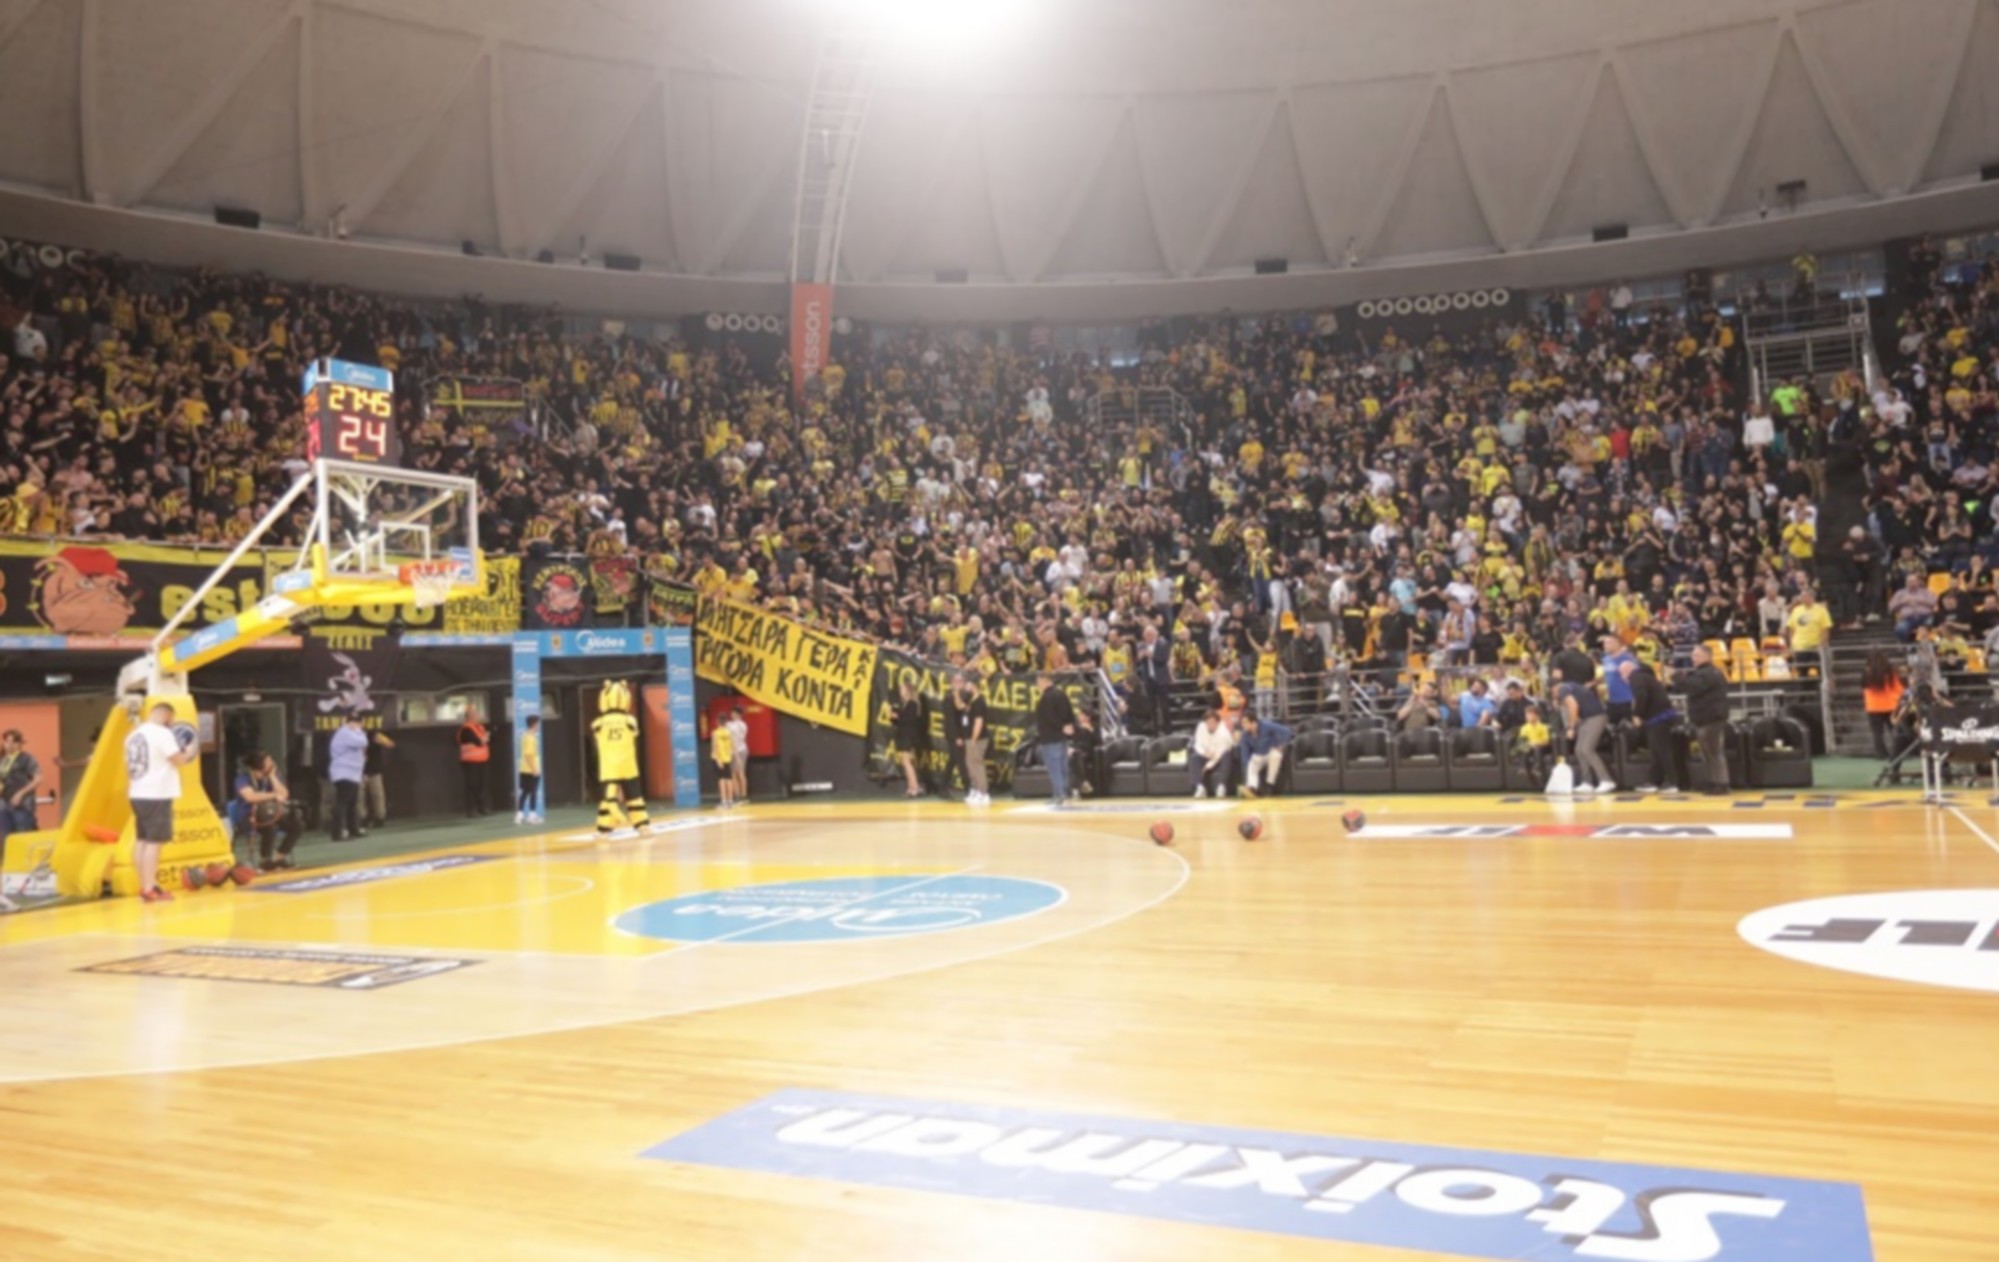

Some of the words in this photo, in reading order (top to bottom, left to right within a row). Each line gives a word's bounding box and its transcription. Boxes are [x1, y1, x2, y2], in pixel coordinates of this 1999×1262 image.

[328, 385, 392, 418] 27:45
[339, 415, 387, 456] 24
[580, 631, 626, 650] Midea
[794, 631, 852, 681] ΓΕΡΑ
[853, 649, 873, 689] ΚΑΙ
[775, 667, 852, 719] ΚΟΝΤΑ
[978, 679, 1084, 713] ΑΔΕΡΕ
[607, 727, 624, 742] 15
[776, 1108, 1787, 1262] Stoiximan
